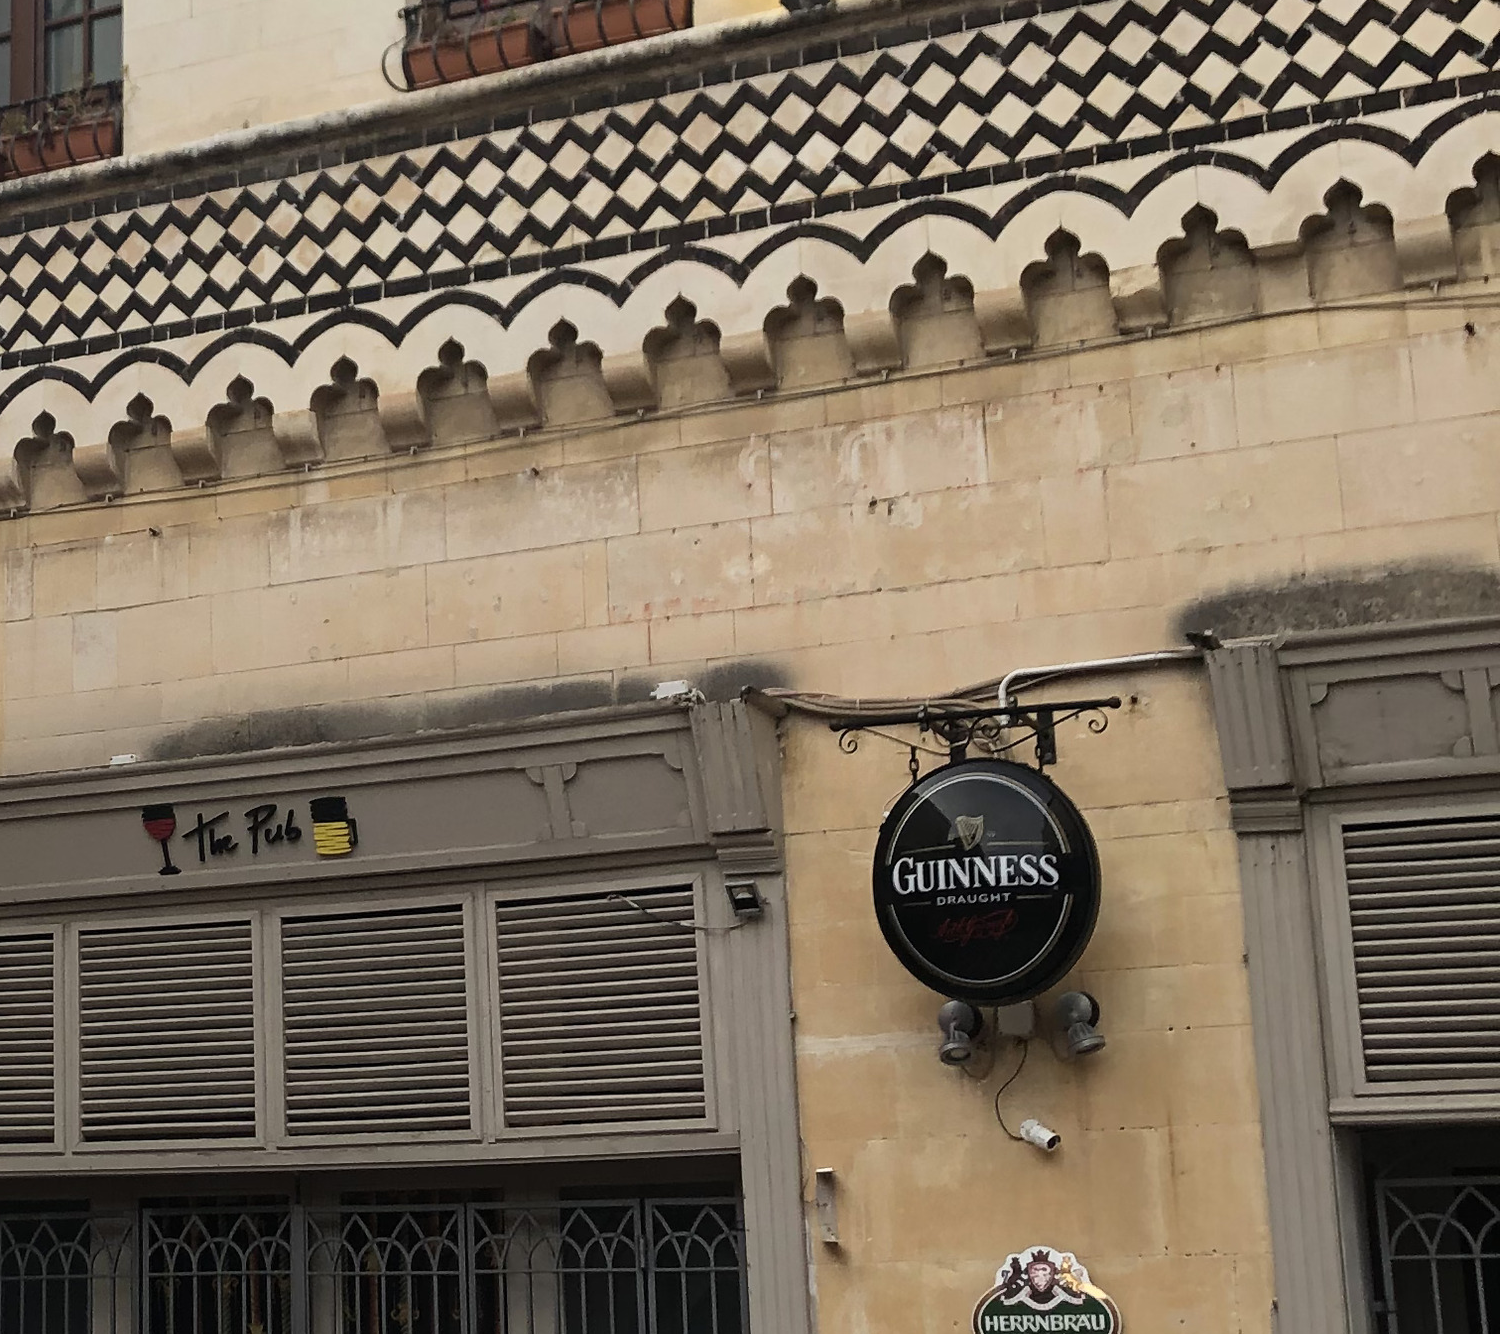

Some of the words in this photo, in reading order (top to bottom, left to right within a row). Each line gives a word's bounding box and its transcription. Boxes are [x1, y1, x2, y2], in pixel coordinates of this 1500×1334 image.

[181, 811, 240, 863] The
[243, 803, 303, 855] Pub
[892, 853, 1060, 896] GUINNESS
[936, 892, 1012, 907] DRAUGHT
[984, 1313, 1106, 1332] HERRNBRÄU
